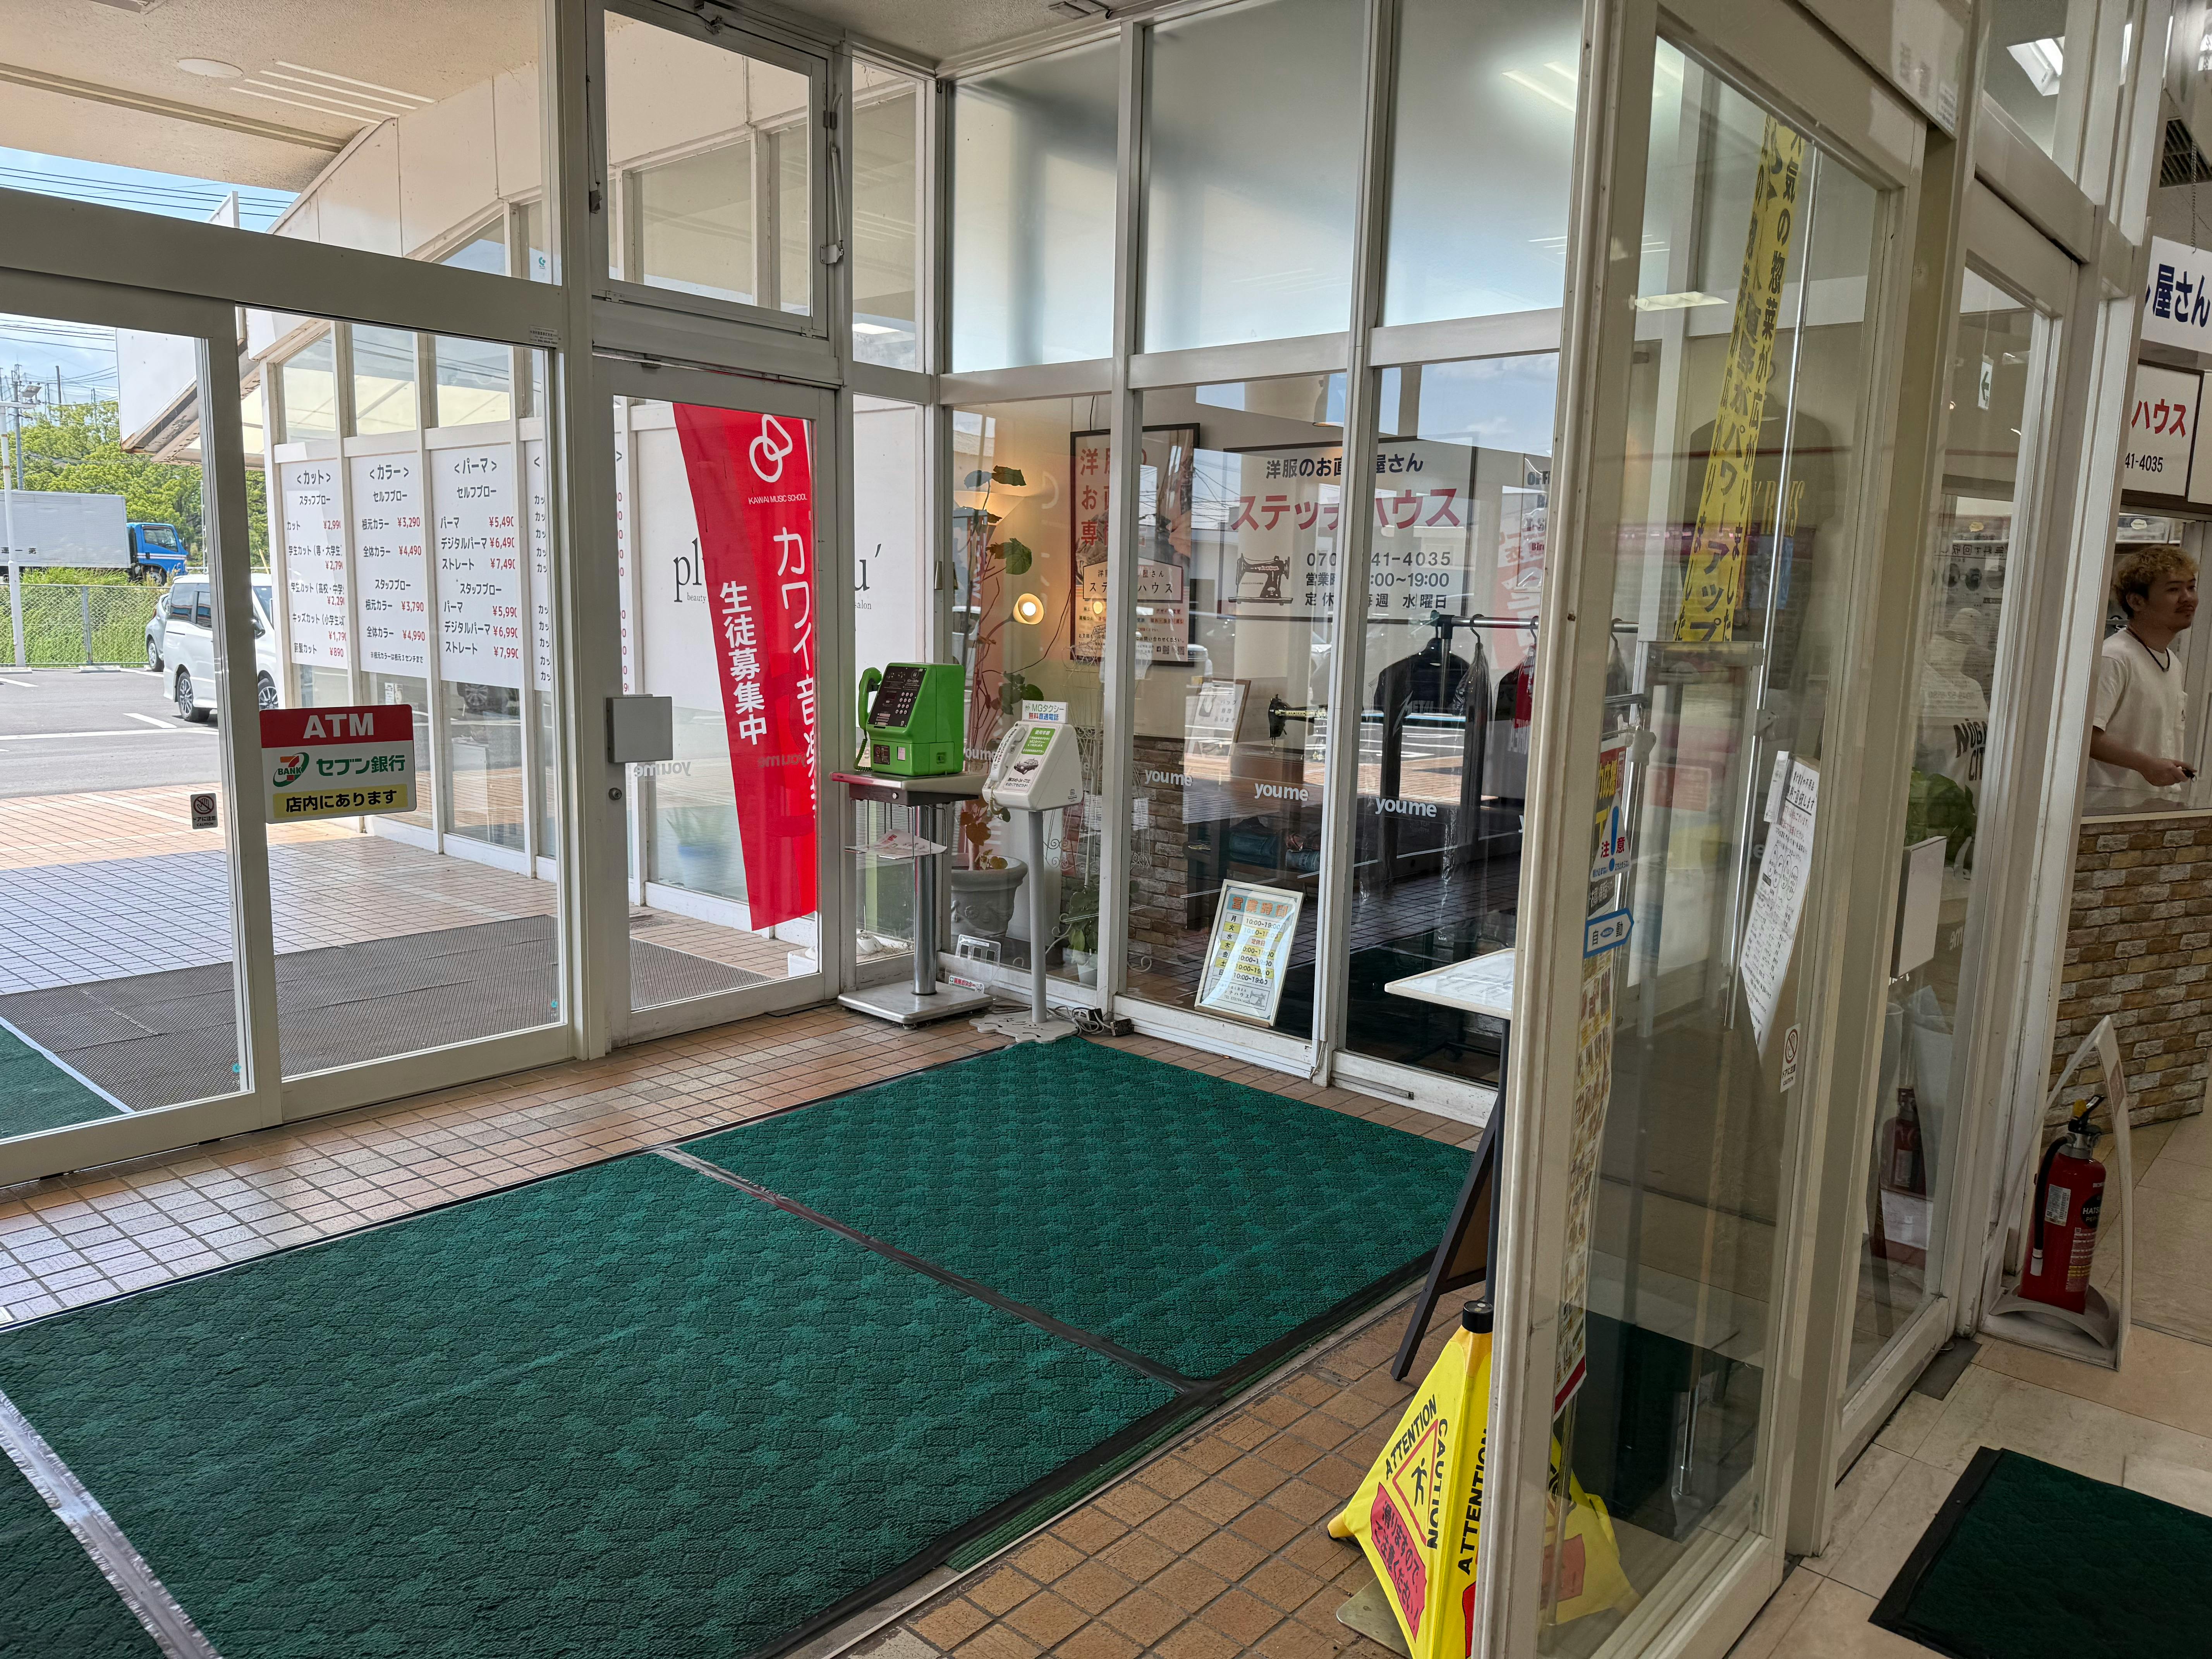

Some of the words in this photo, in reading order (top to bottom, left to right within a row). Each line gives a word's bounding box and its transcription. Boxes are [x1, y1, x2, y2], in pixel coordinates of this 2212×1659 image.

[2146, 263, 2211, 328] 屋さん
[2131, 398, 2187, 438] ハウス
[373, 490, 407, 502] セルフブロー
[457, 485, 497, 498] セルフブロー
[299, 494, 331, 505] スタッフブロー
[748, 496, 769, 505] KAWAI
[770, 495, 787, 503] MUSIC
[787, 493, 808, 502] SCHOOL
[287, 520, 301, 531] カット
[397, 517, 421, 528] ¥3,290
[440, 516, 460, 529] パーマ
[441, 536, 487, 550] デジタルパーマ
[363, 545, 391, 558] 全体カラー
[398, 545, 422, 557] ¥4,490
[325, 560, 343, 571] ¥2,79
[442, 558, 474, 570] ストレート
[375, 579, 411, 591] スタッフブロー
[460, 582, 502, 595] スタッフブロー
[327, 596, 345, 606] ¥2,29
[401, 601, 424, 612] ¥3,790
[444, 600, 463, 613] パーマ
[366, 626, 394, 638] 全体カラー
[402, 630, 425, 641] ¥4,990
[444, 620, 491, 635] デジタルパーマ
[330, 647, 344, 658] ¥890
[446, 641, 478, 655] ストレート
[719, 580, 768, 746] 生徒募集中
[1032, 704, 1065, 713] MGタクシー
[303, 712, 374, 739] ATM
[964, 748, 996, 762] oume
[277, 765, 303, 776] BANK
[316, 754, 405, 776] セブン銀行
[1968, 747, 1985, 781] CIT
[1145, 769, 1193, 787] youme
[1254, 781, 1309, 802] youme
[285, 789, 397, 813] 店内にあります
[1375, 795, 1437, 818] youme
[1601, 840, 1610, 858] 注
[1616, 836, 1625, 854] 意
[1231, 896, 1289, 918] 営業時間
[1251, 938, 1266, 946] 定休日
[2082, 1207, 2100, 1215] HATS
[1385, 1394, 1437, 1480] ATTENTION
[1427, 1419, 1448, 1549] CAUTION
